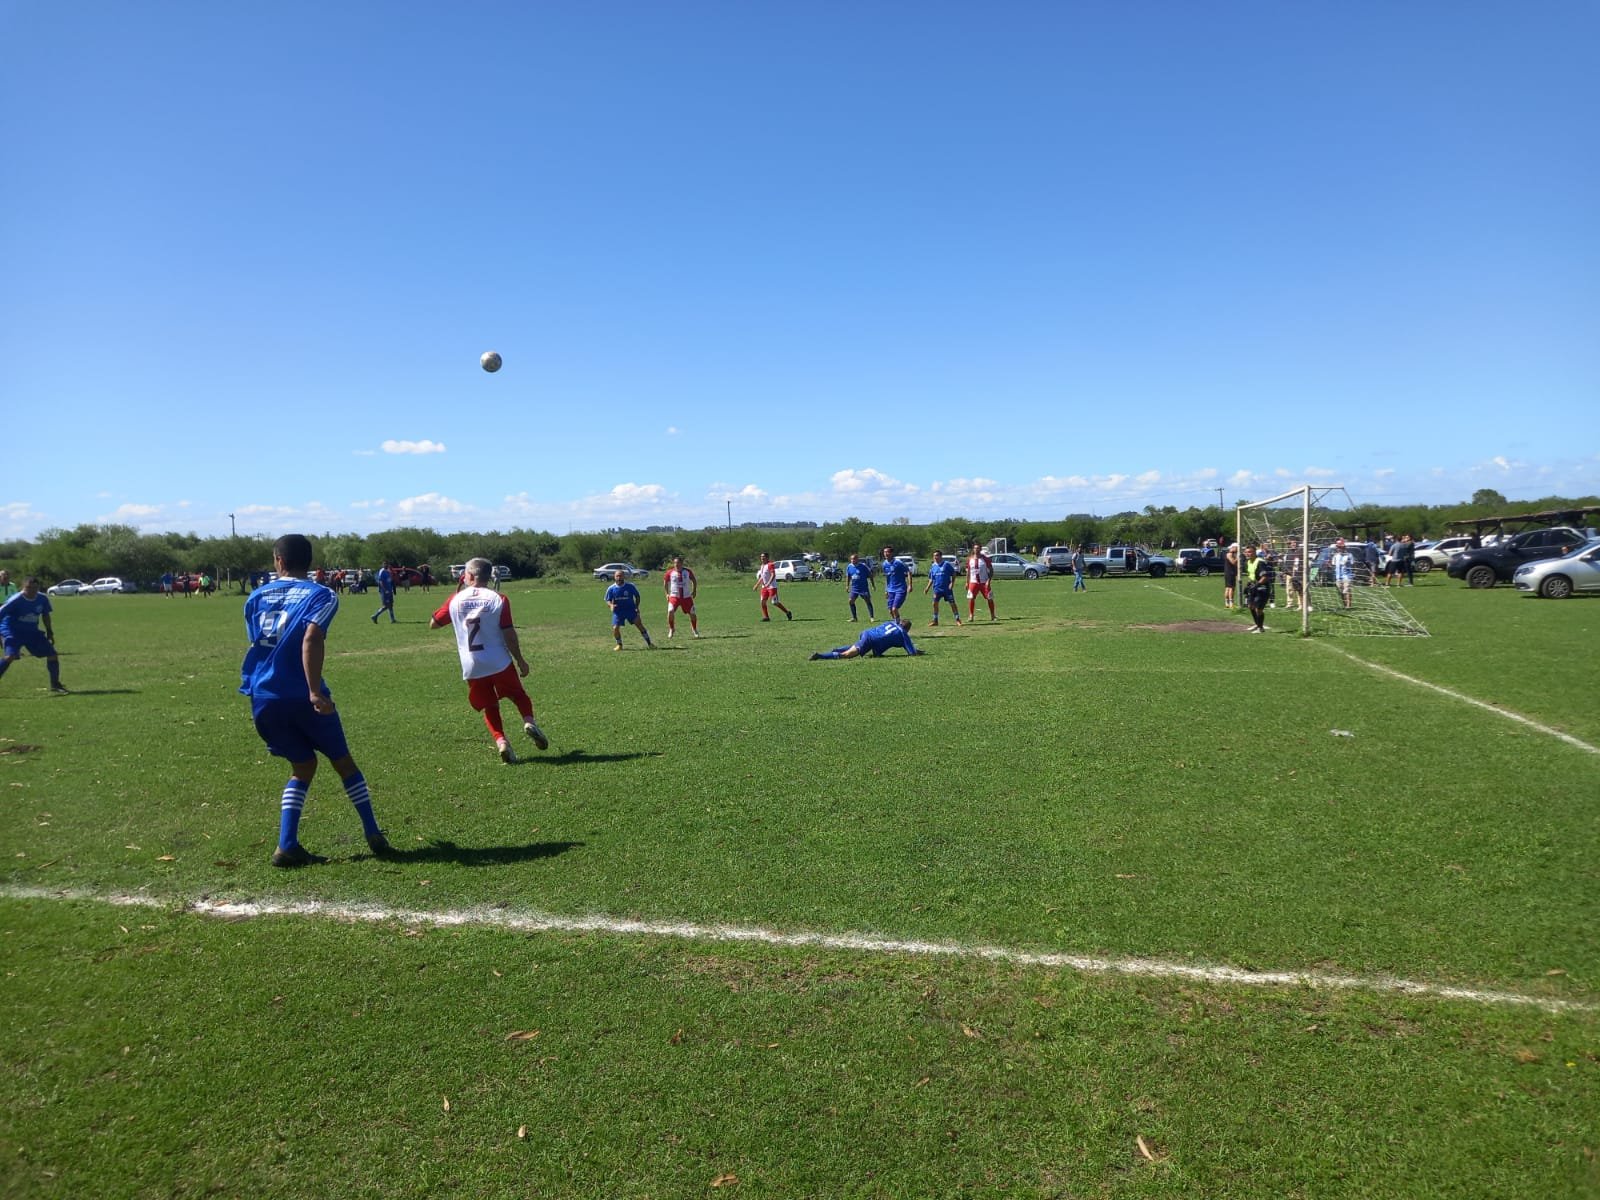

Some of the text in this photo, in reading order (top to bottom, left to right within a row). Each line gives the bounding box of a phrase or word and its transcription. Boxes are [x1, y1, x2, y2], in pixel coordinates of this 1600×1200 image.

[259, 610, 288, 648] 9
[465, 616, 485, 652] 2
[884, 623, 897, 635] 4
